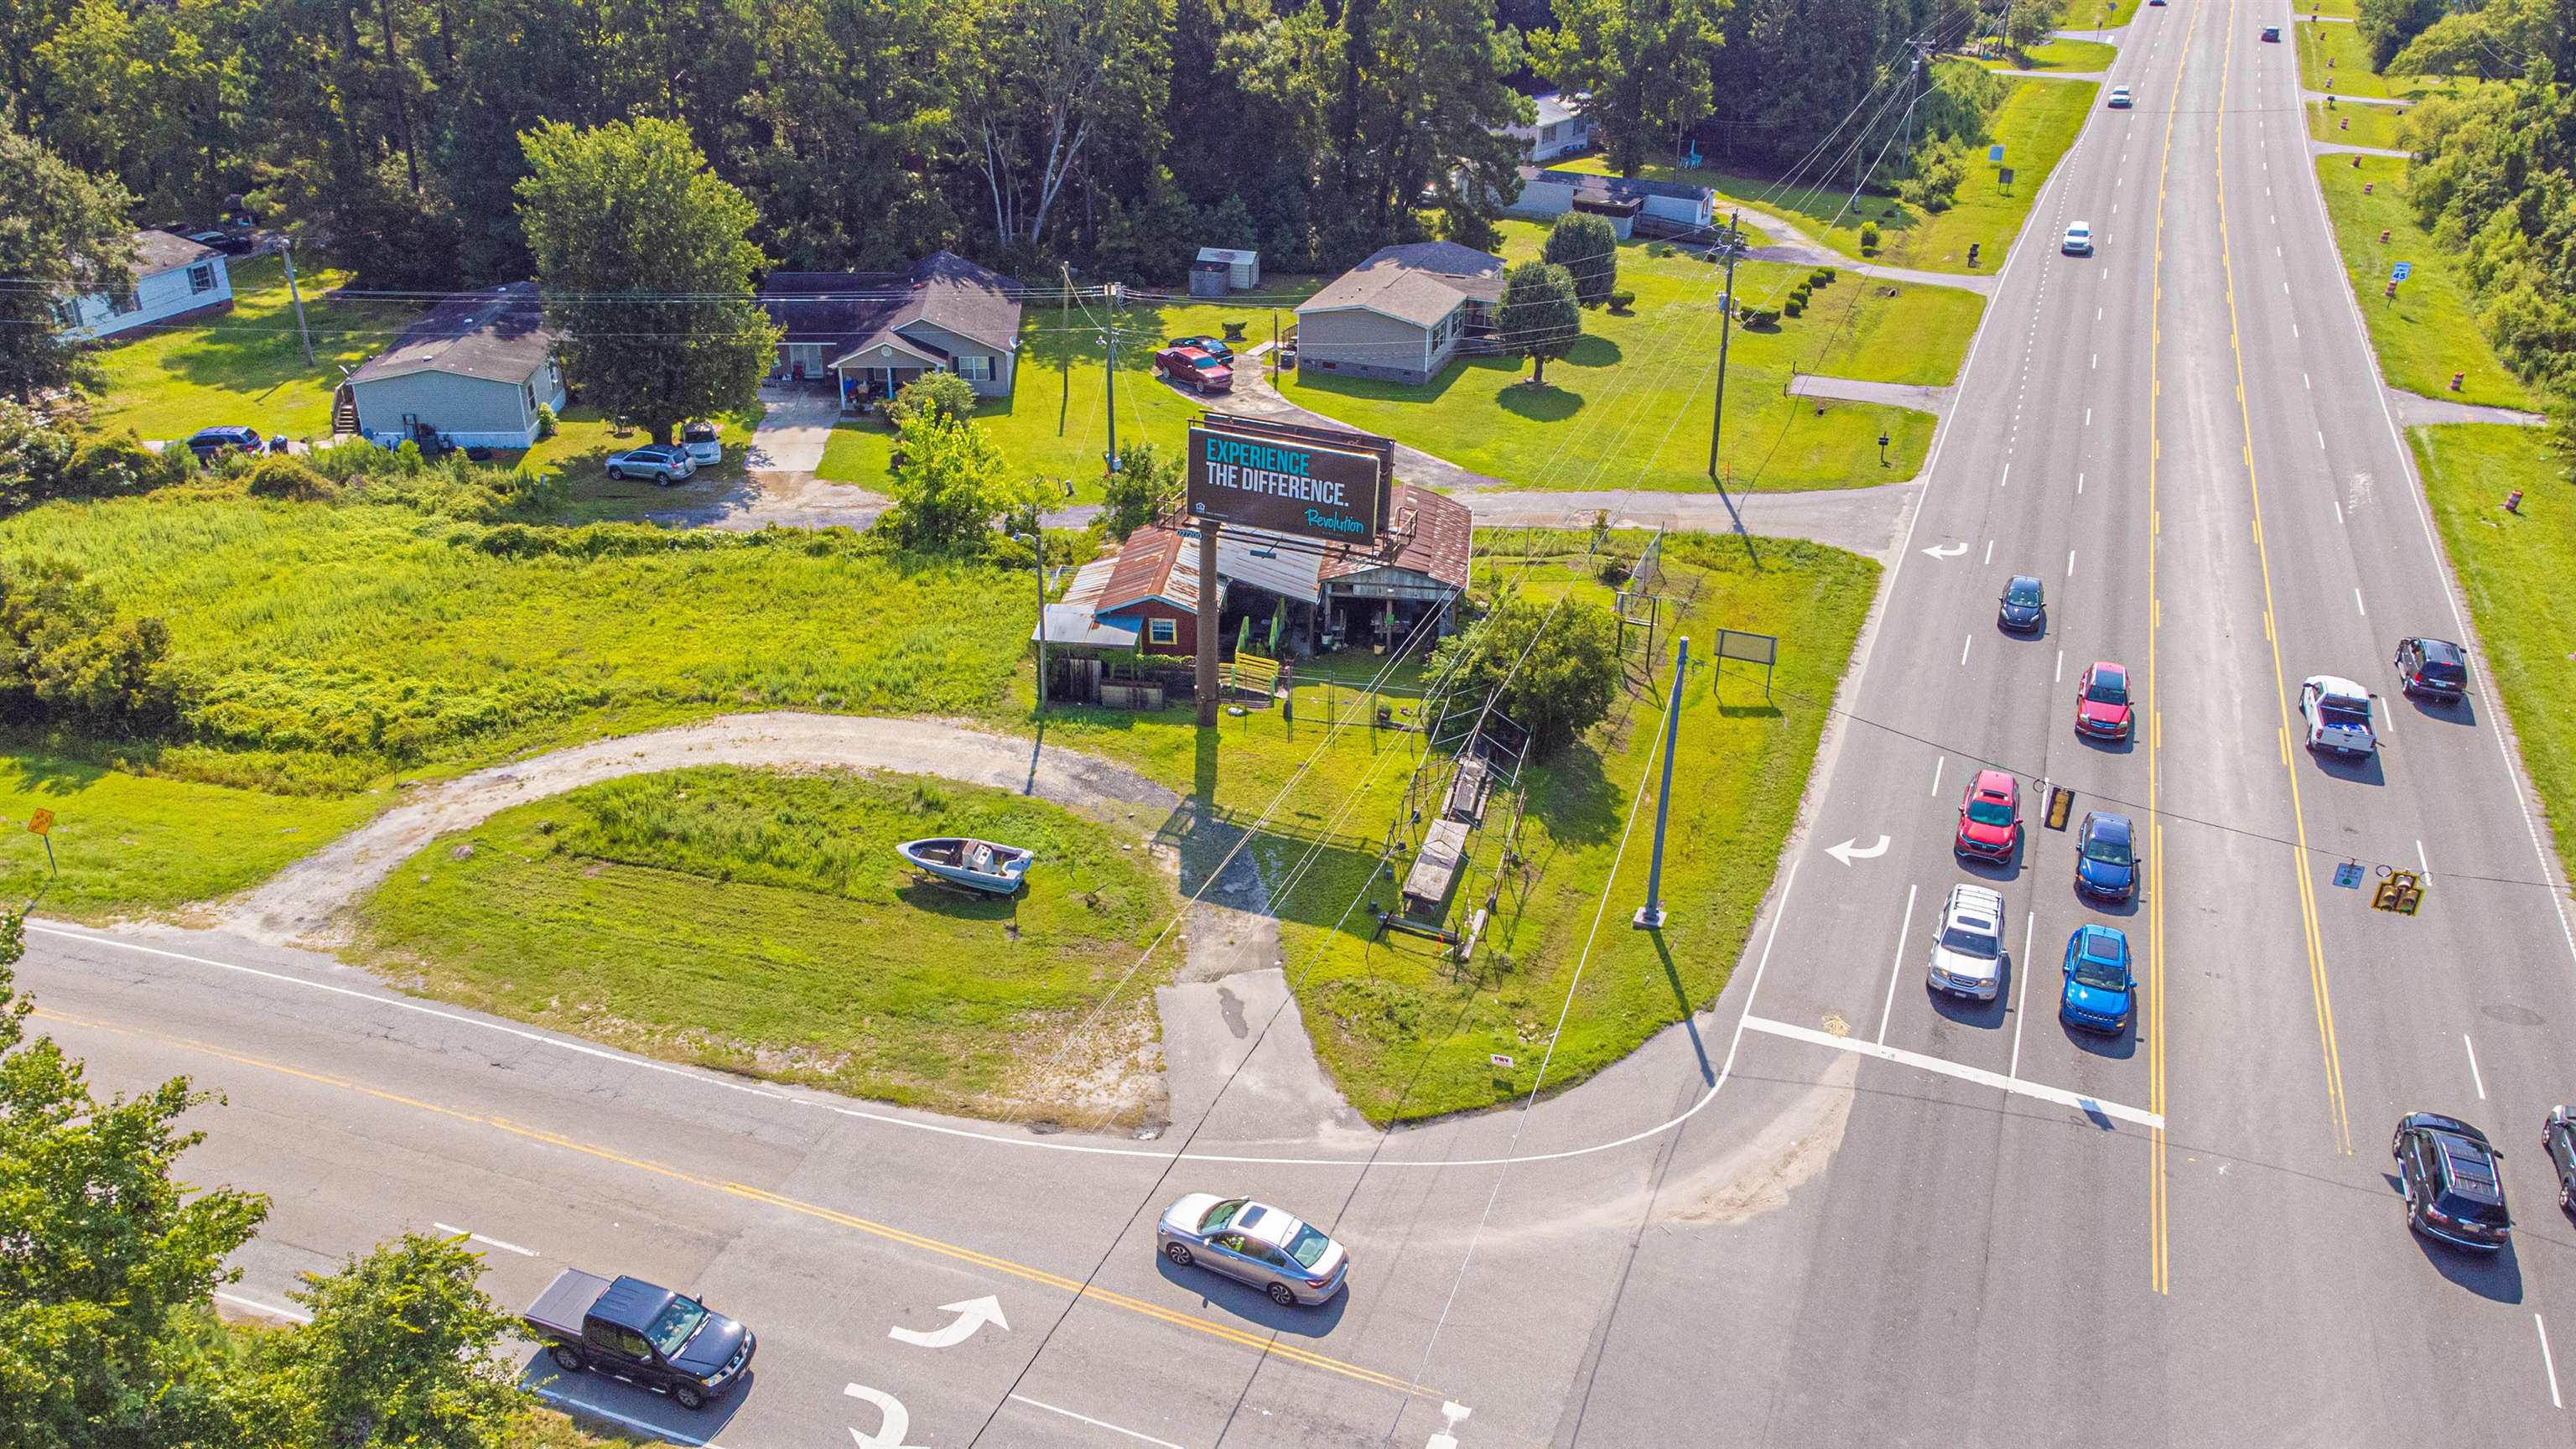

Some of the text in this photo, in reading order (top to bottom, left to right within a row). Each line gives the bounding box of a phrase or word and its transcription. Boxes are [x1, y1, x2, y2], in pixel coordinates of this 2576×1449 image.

[2393, 272, 2407, 280] 45
[1207, 438, 1311, 476] EXPERIENCE
[1206, 461, 1349, 507] THE DIFFERENCE.
[1305, 508, 1364, 534] Revolution
